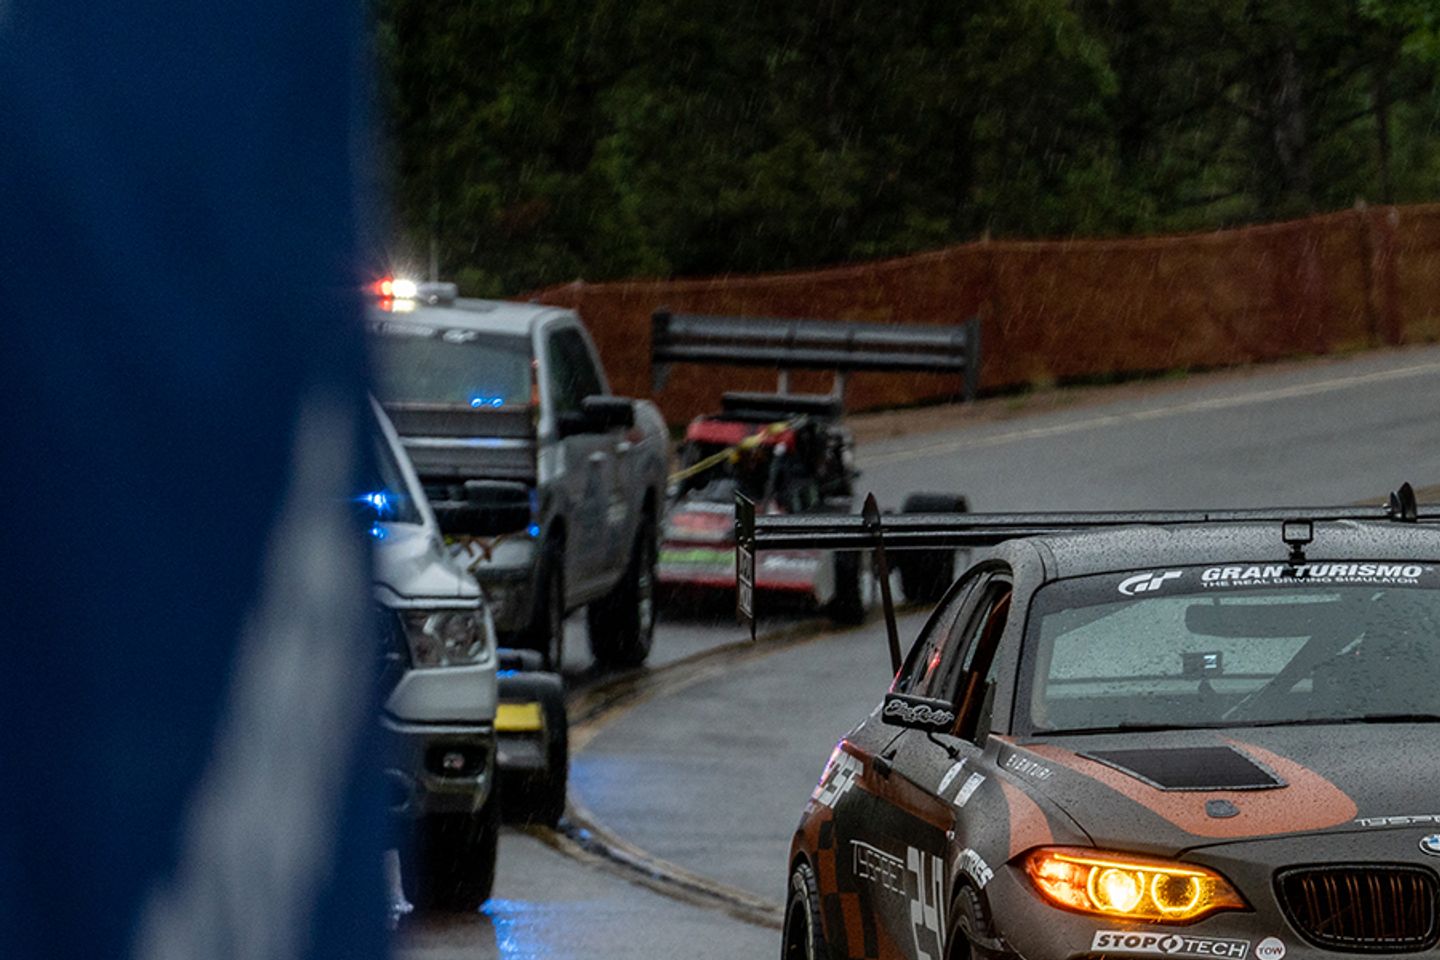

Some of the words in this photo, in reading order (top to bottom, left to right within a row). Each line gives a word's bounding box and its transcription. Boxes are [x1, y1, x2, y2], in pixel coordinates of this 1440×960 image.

[1201, 565, 1284, 581] GRAN
[1293, 564, 1423, 578] TURISMO
[1201, 580, 1230, 588] THE
[1259, 945, 1282, 956] TOW
